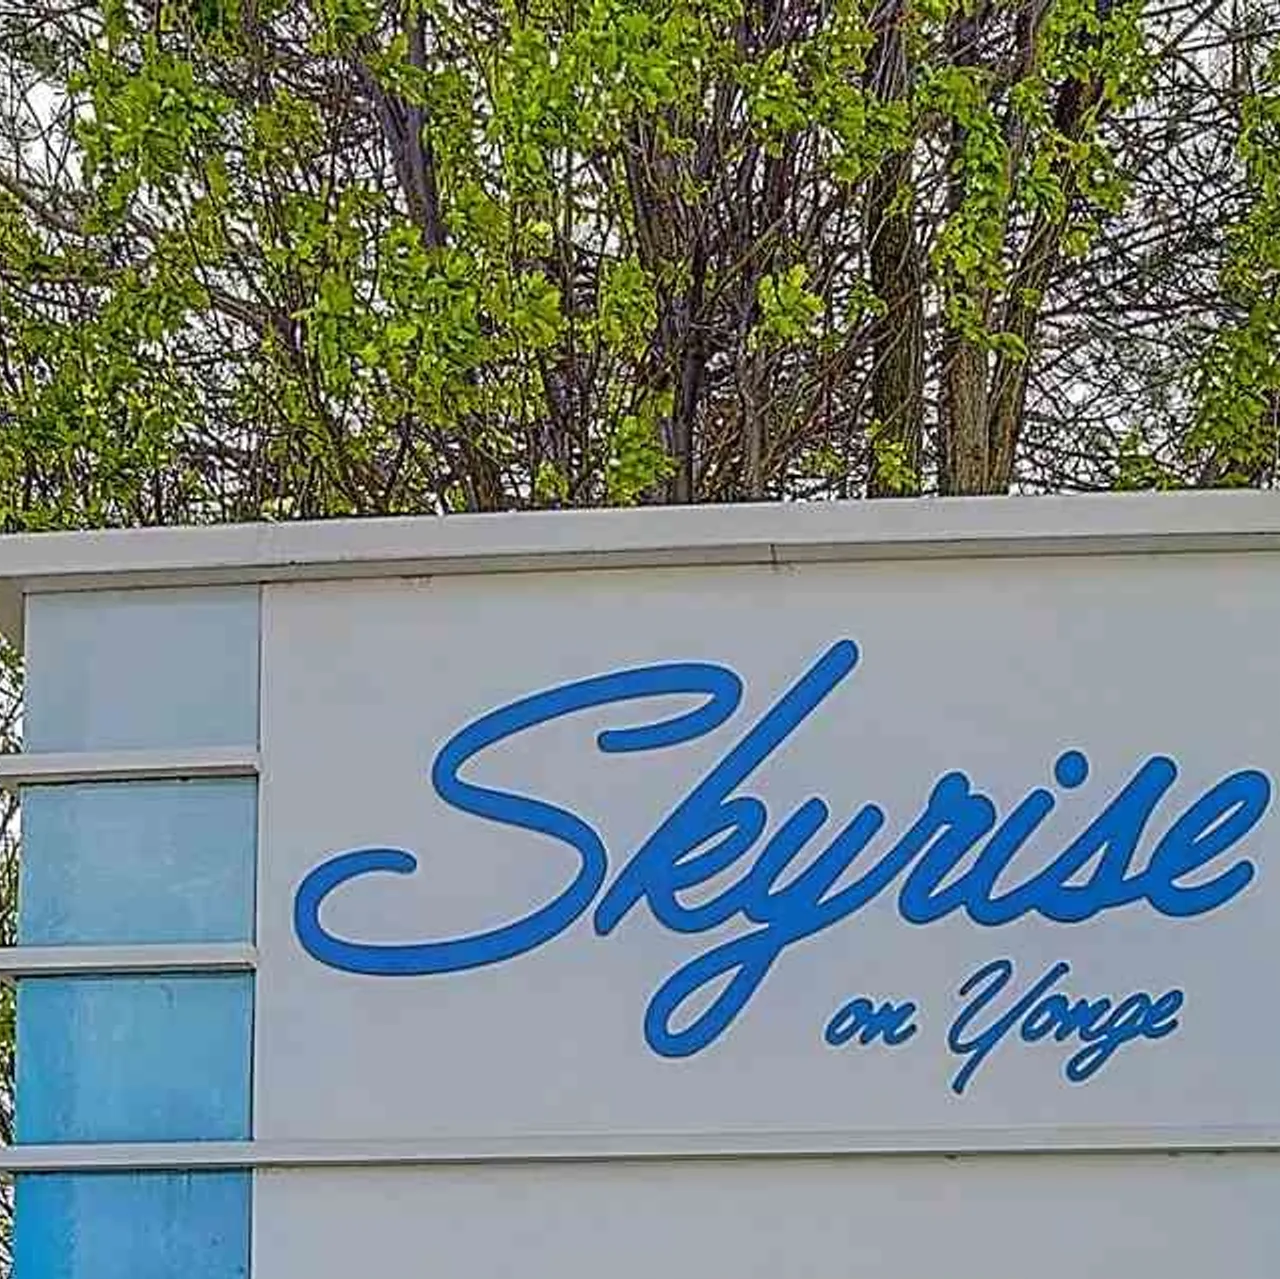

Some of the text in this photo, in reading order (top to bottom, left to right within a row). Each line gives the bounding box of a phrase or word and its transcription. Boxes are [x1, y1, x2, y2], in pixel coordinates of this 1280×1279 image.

[293, 638, 1272, 1058] Skyrise
[824, 959, 1185, 1094] on Yonge
